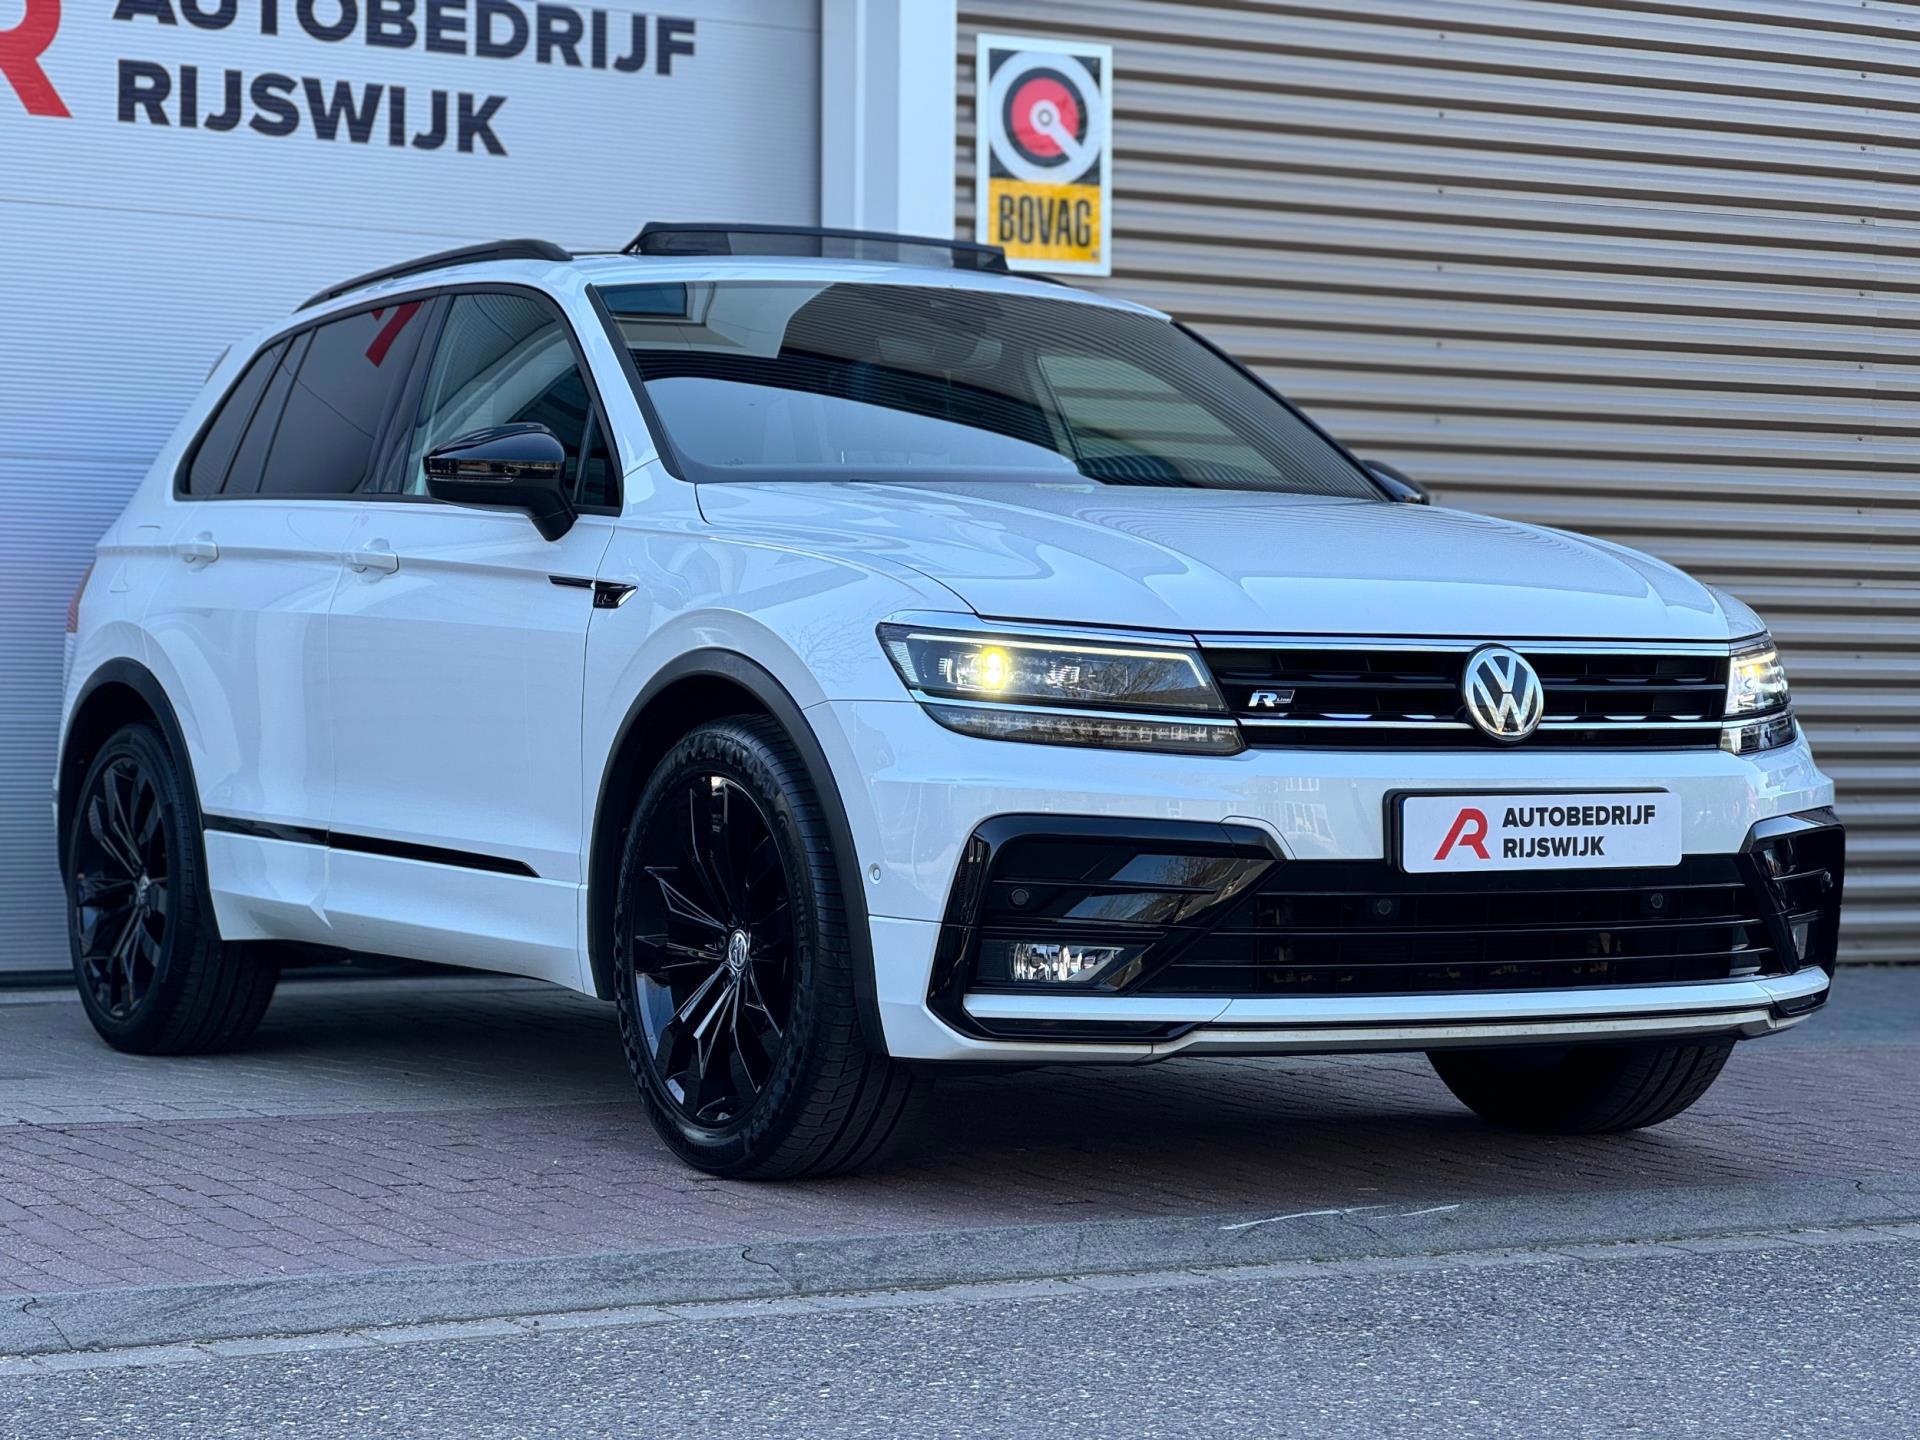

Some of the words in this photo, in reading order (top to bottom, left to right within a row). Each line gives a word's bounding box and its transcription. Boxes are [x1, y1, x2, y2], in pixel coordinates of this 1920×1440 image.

[117, 58, 508, 157] RIJSWIJK
[999, 194, 1092, 247] BOVAG
[1502, 805, 1656, 828] AUTOBEDRIJF
[1503, 836, 1605, 859] RIJSWIJK
